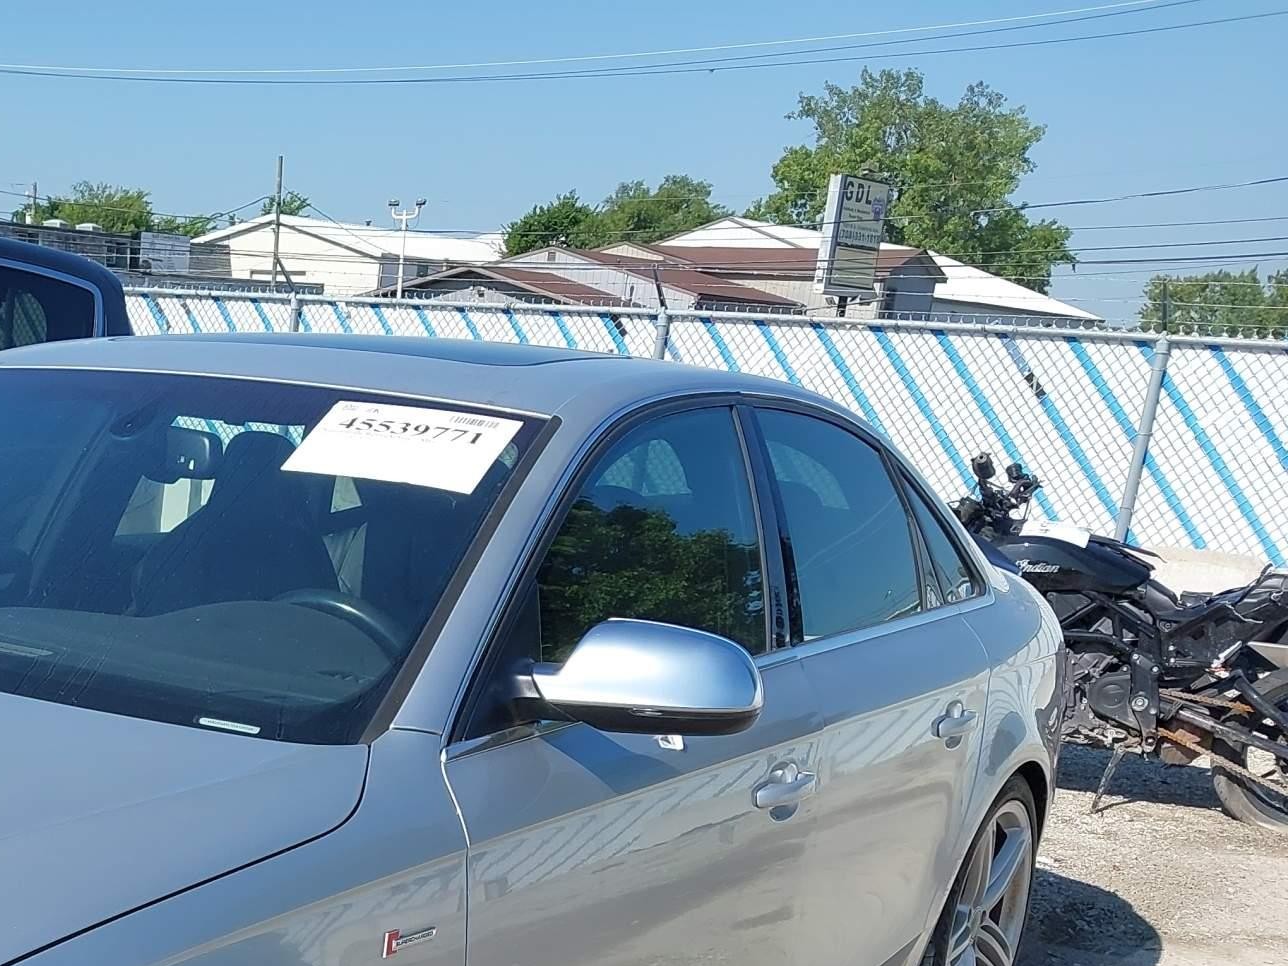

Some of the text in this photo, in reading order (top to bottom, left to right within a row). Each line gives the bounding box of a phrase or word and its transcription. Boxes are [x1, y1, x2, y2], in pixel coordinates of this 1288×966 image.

[844, 180, 872, 205] GDL
[338, 416, 484, 445] 45539771
[1015, 558, 1061, 573] Indian
